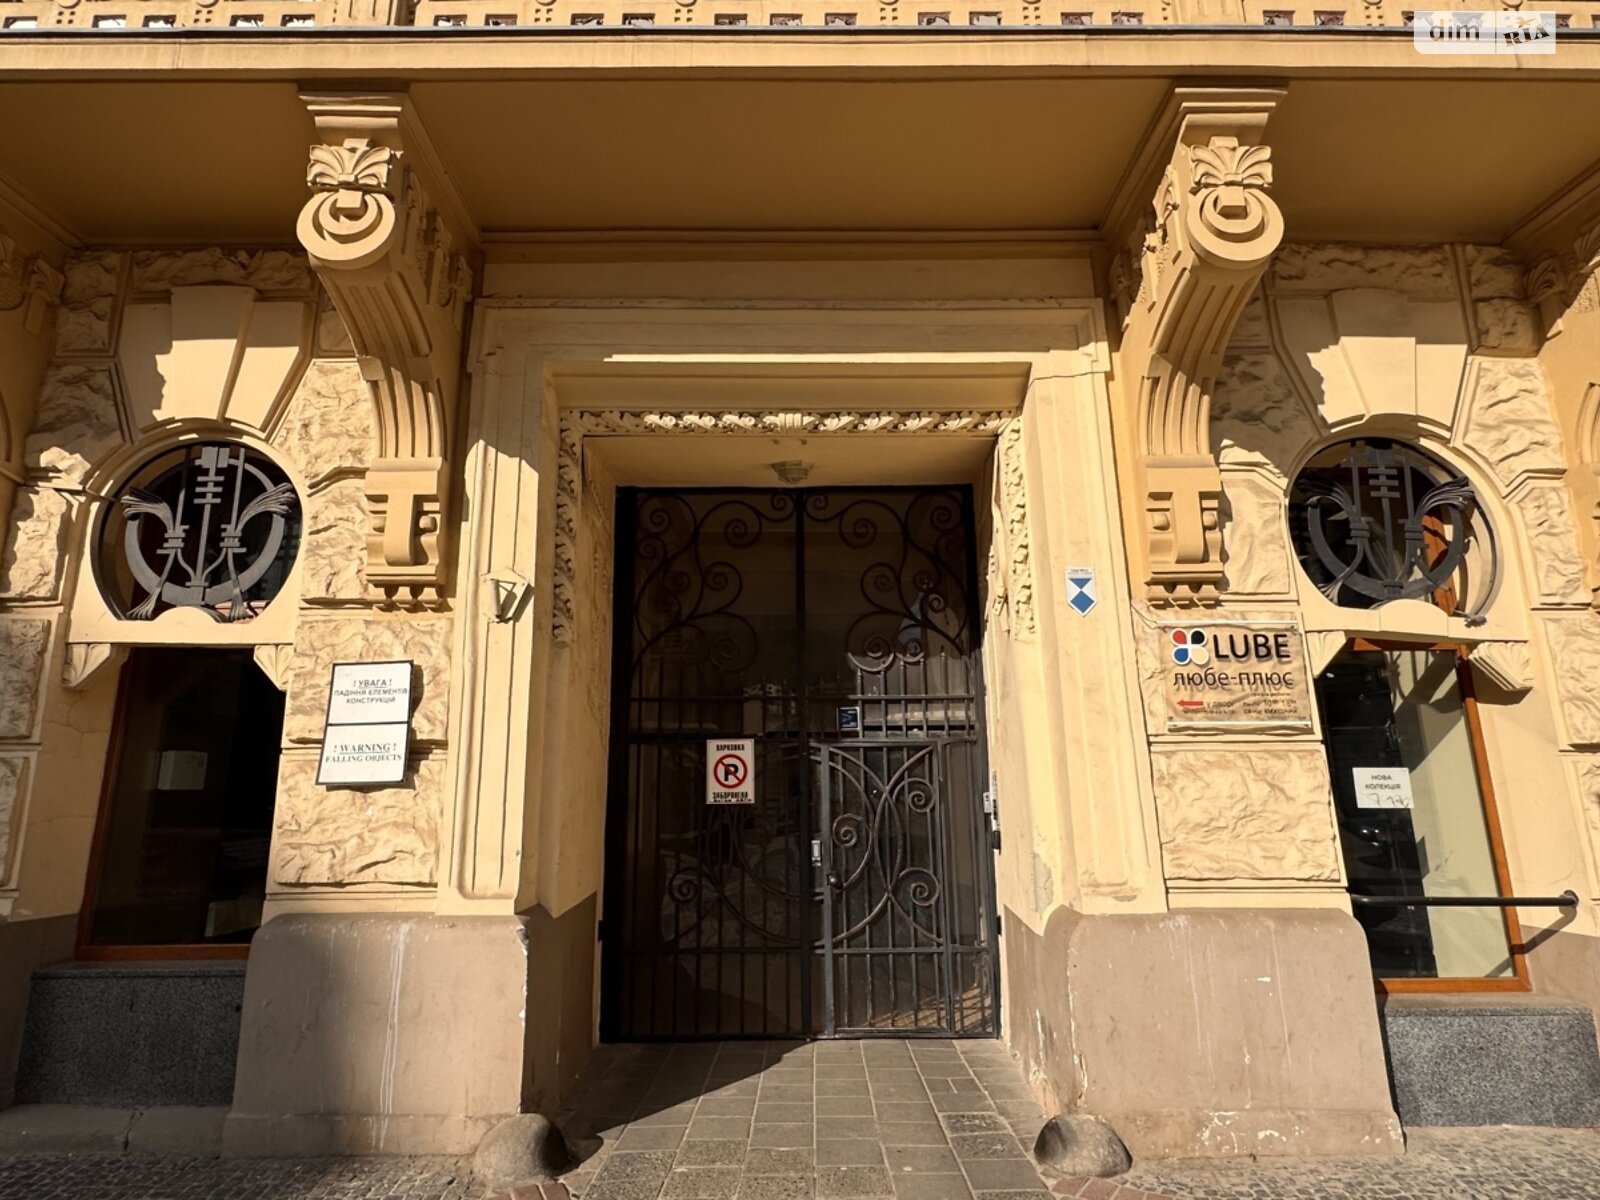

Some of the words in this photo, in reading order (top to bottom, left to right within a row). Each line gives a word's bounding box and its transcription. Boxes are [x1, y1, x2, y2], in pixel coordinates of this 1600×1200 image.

[1213, 633, 1291, 659] LUBE
[1173, 666, 1294, 686] любе-плюс
[358, 679, 387, 687] УВАГА
[346, 696, 396, 704] КОНСТРУКЦІЙ
[339, 743, 391, 752] WARNING
[325, 755, 363, 763] FALLING
[365, 754, 402, 762] OBJECTS
